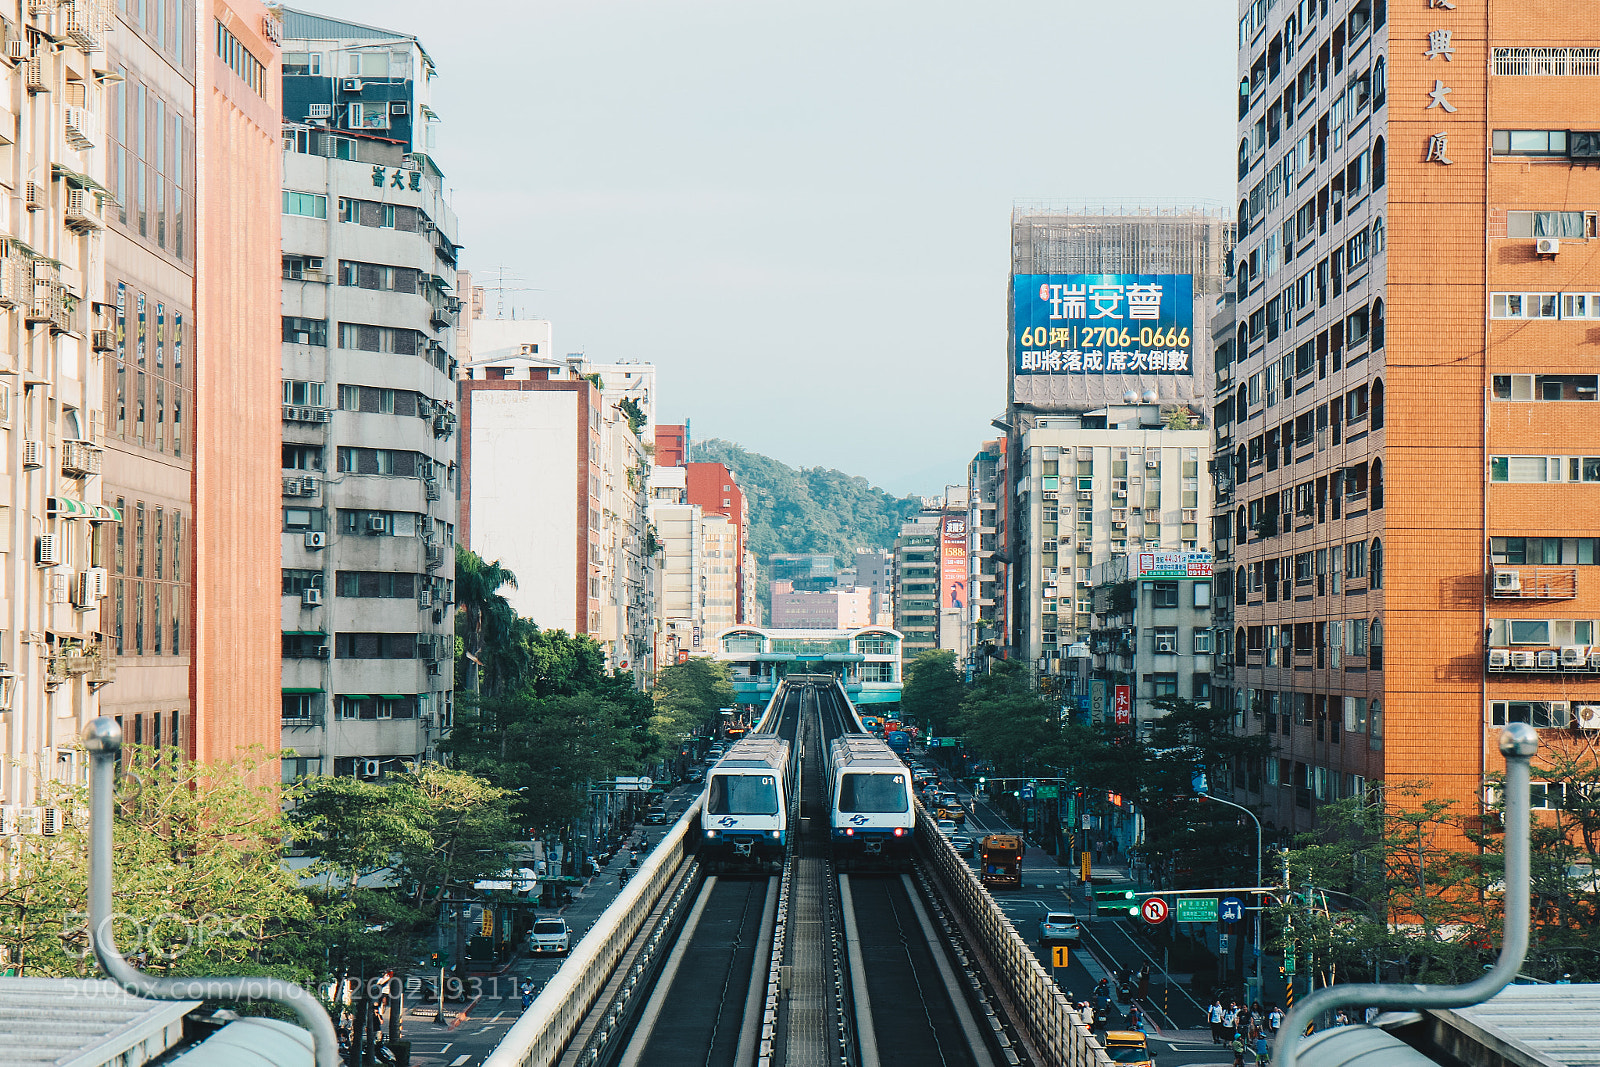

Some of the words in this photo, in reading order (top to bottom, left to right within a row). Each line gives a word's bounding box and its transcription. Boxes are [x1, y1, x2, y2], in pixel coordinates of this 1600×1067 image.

[1081, 326, 1190, 348] 2706-0666
[1021, 350, 1103, 371] 即將落成
[1106, 350, 1189, 371] 席次倒數
[1116, 692, 1128, 724] 永和
[761, 777, 775, 785] 01
[892, 776, 903, 784] 41
